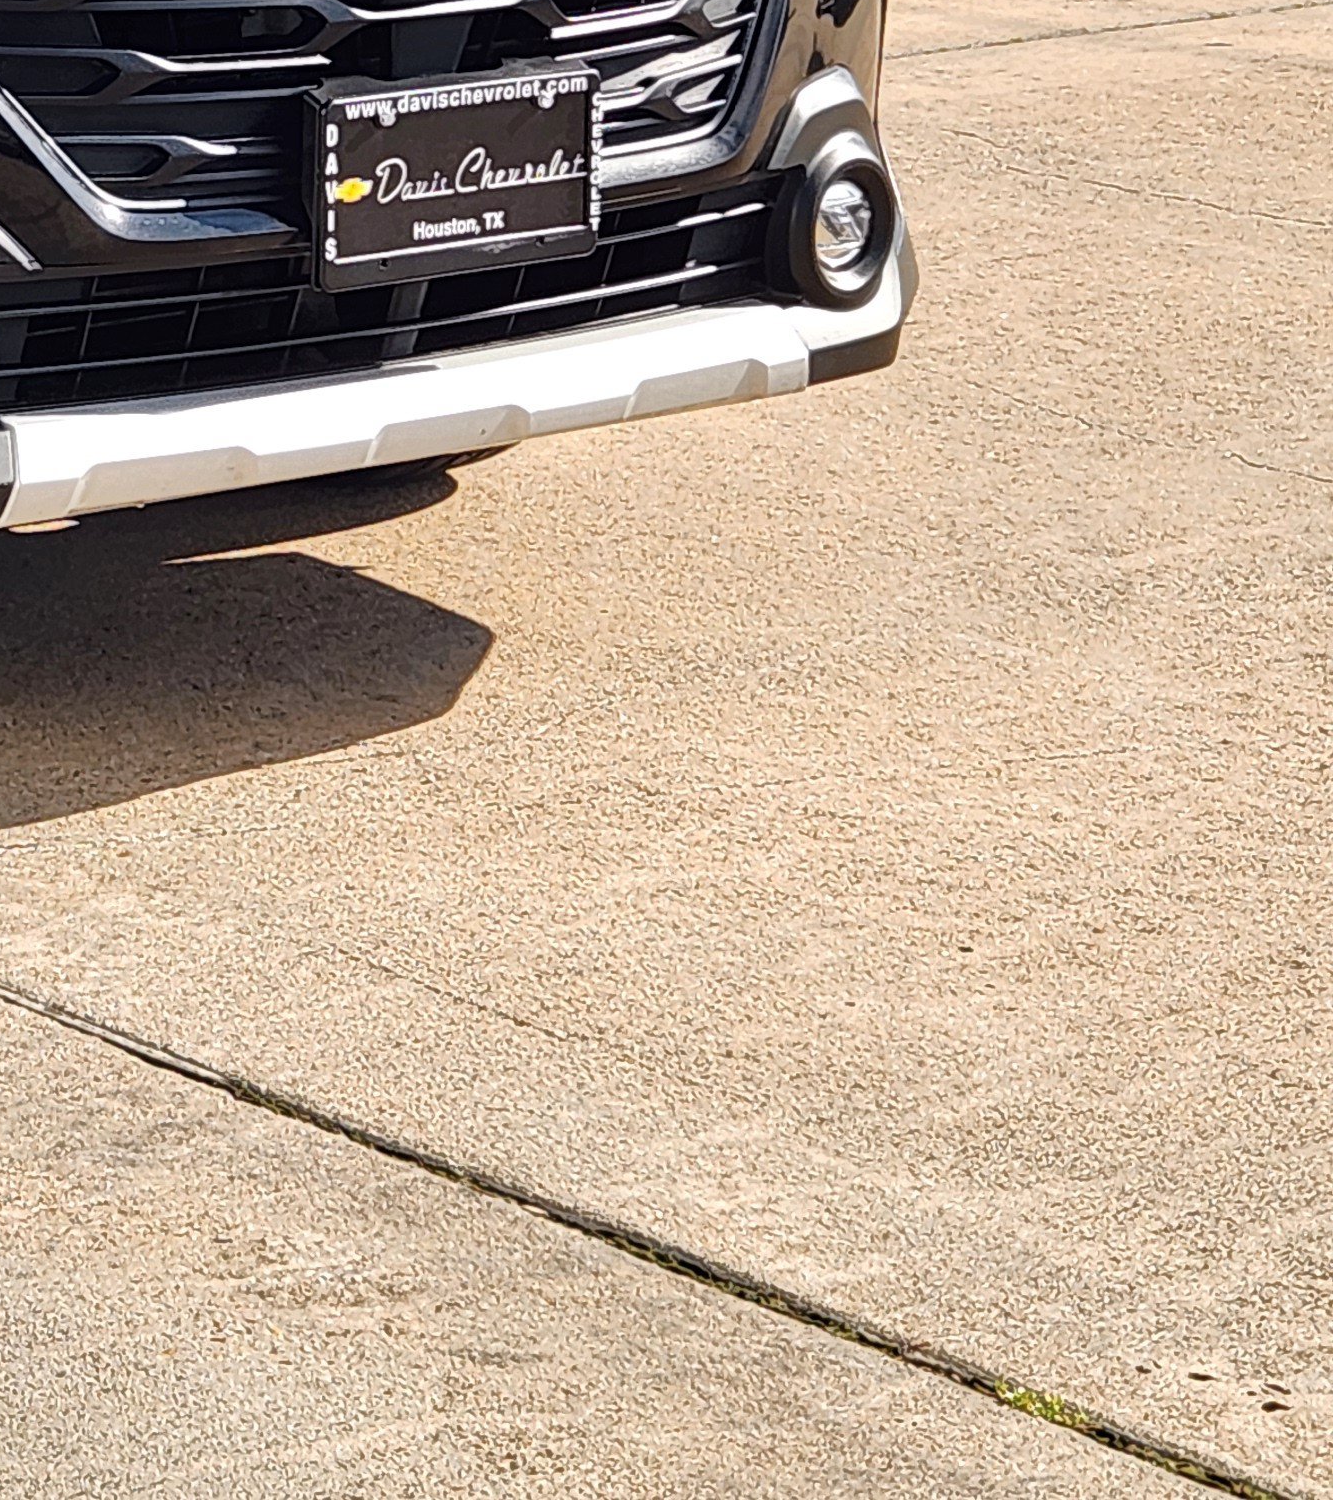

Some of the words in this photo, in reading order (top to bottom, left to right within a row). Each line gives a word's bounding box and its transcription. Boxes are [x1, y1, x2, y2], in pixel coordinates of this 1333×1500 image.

[345, 76, 588, 120] www.davischevrolet.com
[375, 157, 454, 203] Davis
[454, 147, 587, 193] Chevrolet
[590, 92, 603, 231] CHEVROLET
[324, 123, 339, 261] DAVIS
[413, 217, 481, 240] Houston,
[483, 211, 505, 229] TX
